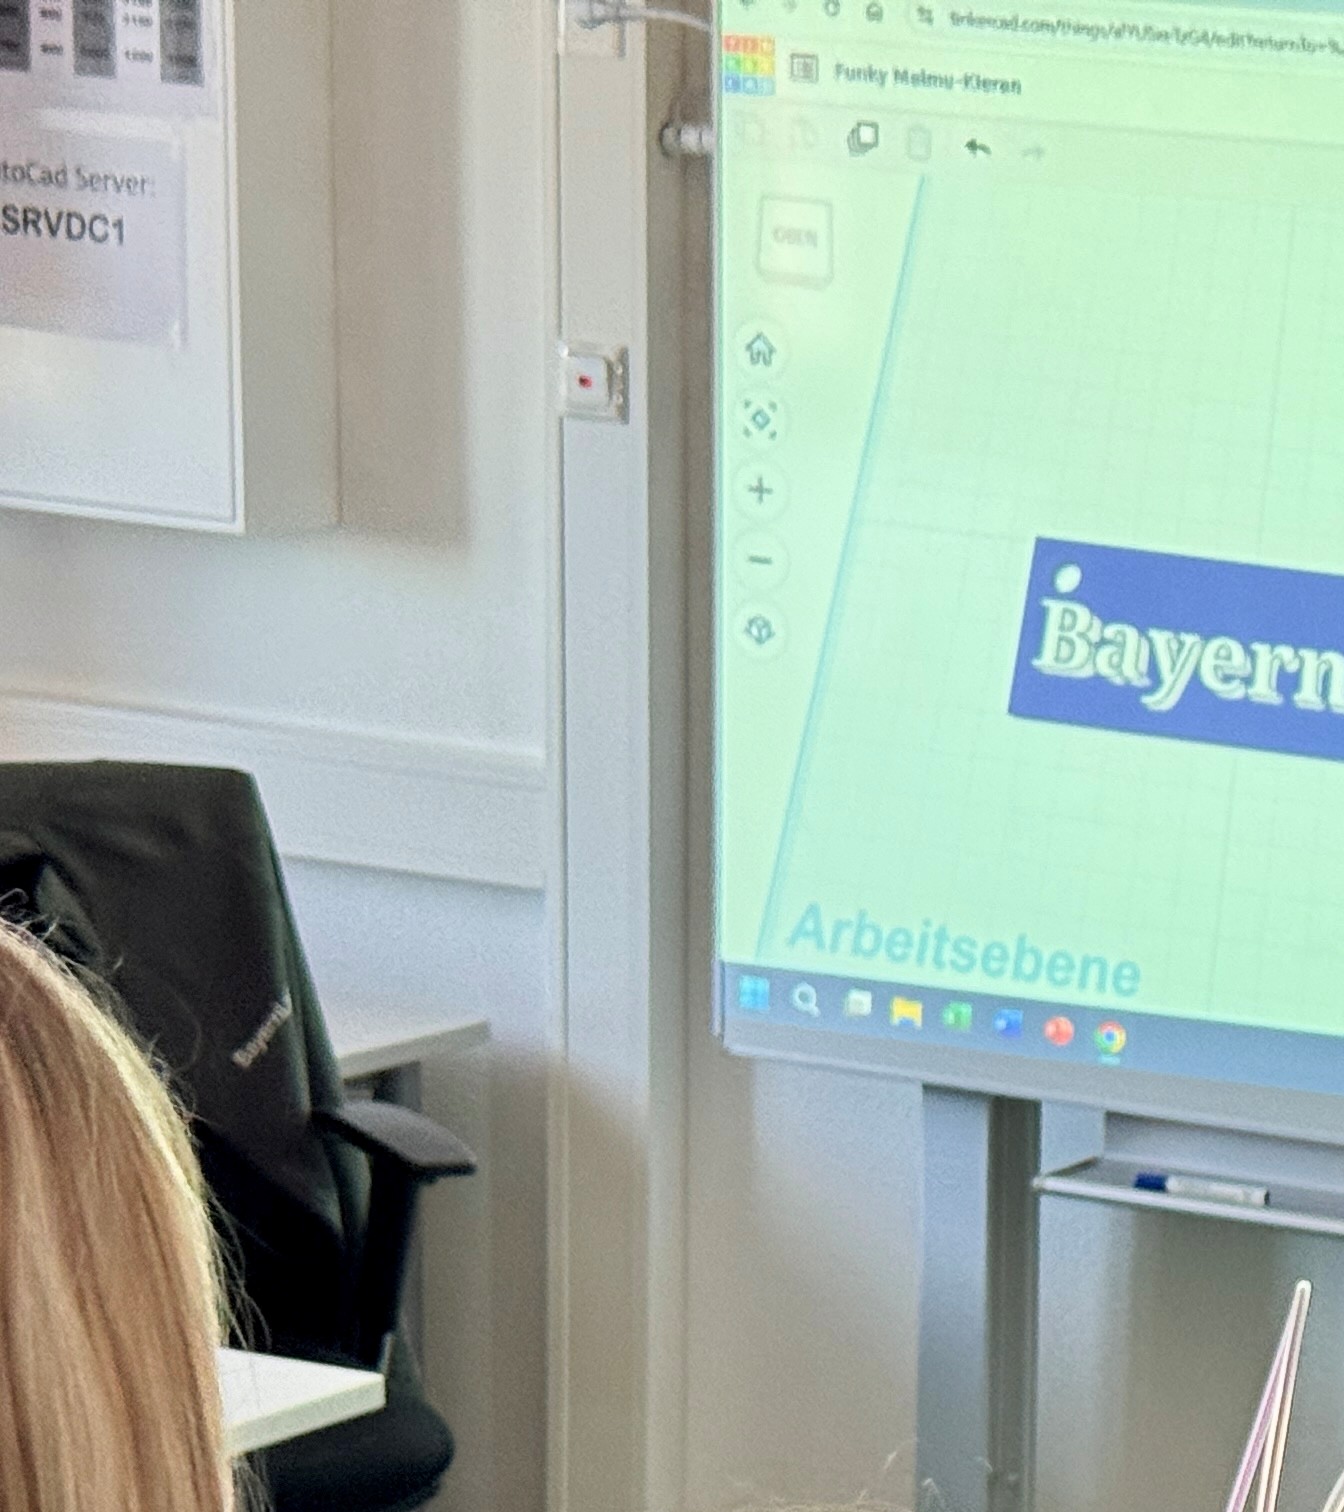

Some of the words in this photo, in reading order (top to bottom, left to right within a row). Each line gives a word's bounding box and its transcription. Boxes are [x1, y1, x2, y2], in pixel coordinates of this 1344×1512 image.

[835, 62, 888, 88] Funky
[2, 203, 125, 246] SRVDC1
[787, 900, 1142, 998] Arbeitsebene
